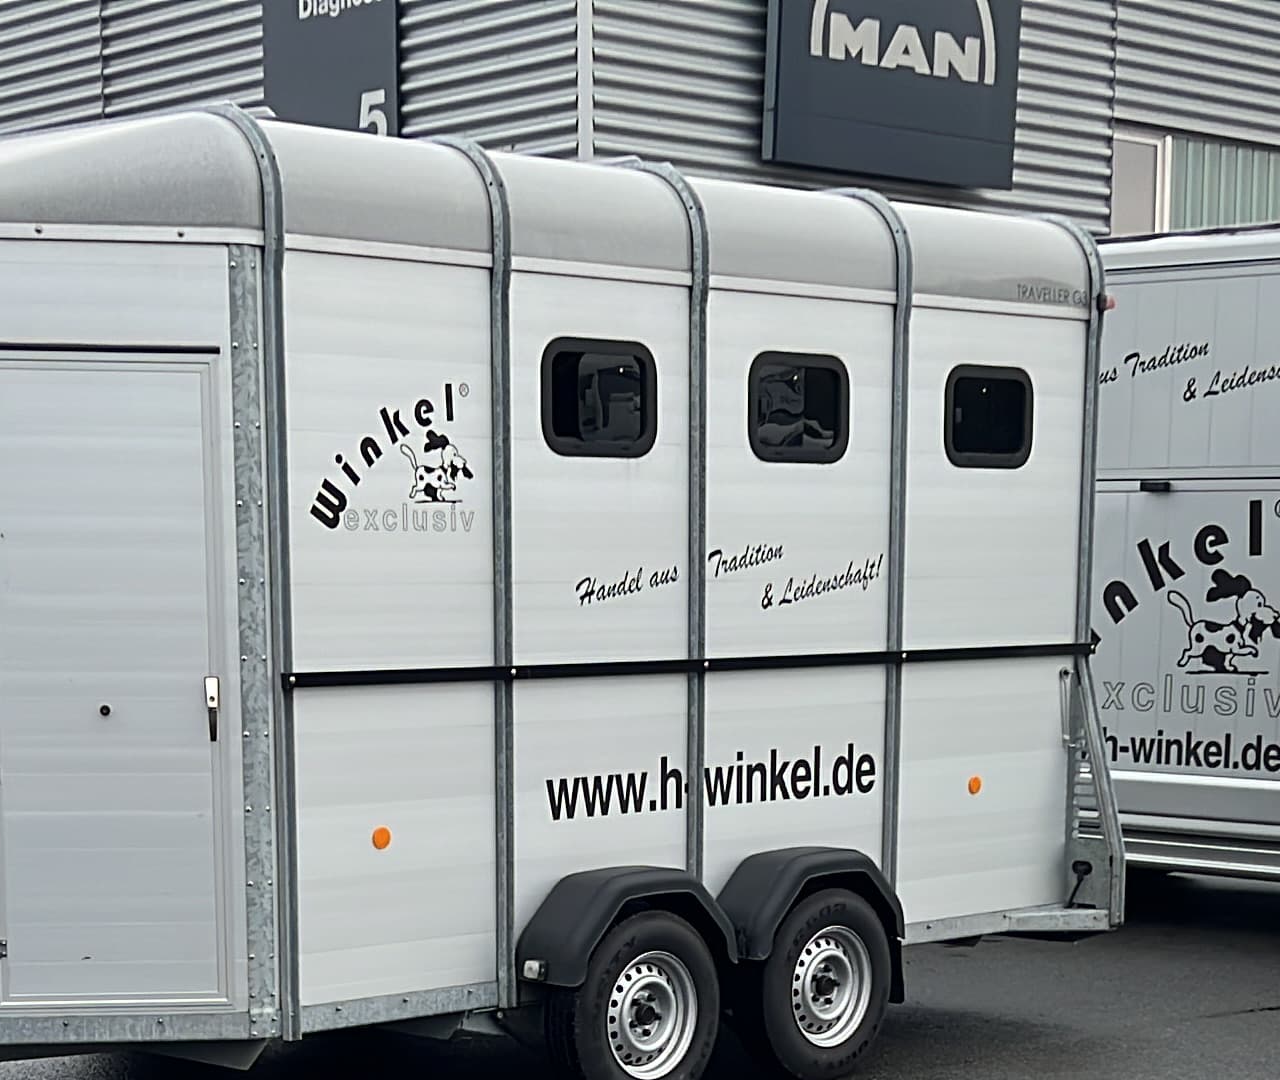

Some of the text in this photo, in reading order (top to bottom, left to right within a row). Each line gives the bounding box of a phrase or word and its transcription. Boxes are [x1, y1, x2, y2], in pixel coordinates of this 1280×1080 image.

[829, 12, 981, 82] MAN
[359, 88, 388, 136] 5
[1124, 341, 1209, 377] Tradition
[1183, 377, 1196, 402] &
[310, 383, 454, 529] winkel
[343, 503, 475, 532] exclusiv
[576, 543, 784, 606] Handel aus Tradition
[761, 553, 884, 609] & Leidenschaft!
[1091, 500, 1263, 645] nkel
[546, 742, 876, 821] www.hwinkel.de
